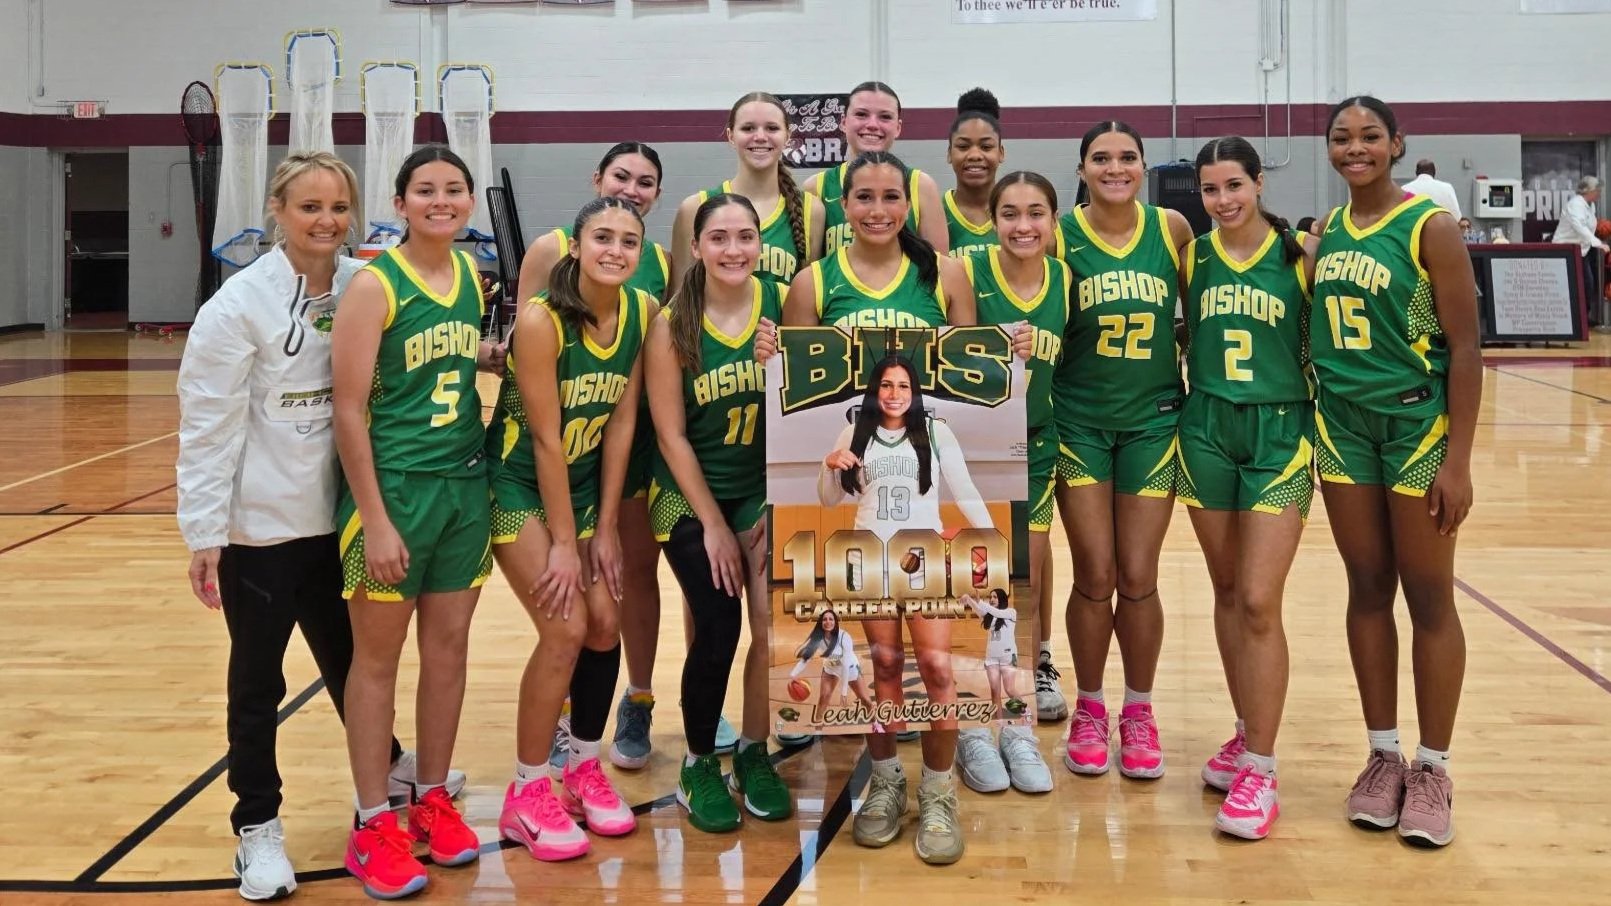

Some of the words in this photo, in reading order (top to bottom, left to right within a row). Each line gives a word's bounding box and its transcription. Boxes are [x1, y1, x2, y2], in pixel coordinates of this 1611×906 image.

[974, 0, 1001, 11] thee
[1070, 0, 1086, 9] be
[1089, 0, 1121, 9] true.
[77, 103, 97, 116] EXIT
[798, 116, 820, 132] To
[816, 116, 838, 132] Be
[799, 99, 820, 116] A
[1078, 270, 1169, 312] BISHOP
[1315, 250, 1391, 296] BISHOP
[1200, 284, 1286, 327] BISHOP
[1325, 295, 1373, 350] 15
[404, 320, 481, 373] BISHO
[1096, 312, 1156, 360] 22
[1223, 329, 1253, 382] 2
[776, 326, 1012, 414] BHS
[430, 370, 461, 428] 5
[723, 403, 759, 446] 11
[877, 486, 911, 522] 13
[783, 528, 1010, 612] 1000
[795, 600, 899, 622] CAREER
[904, 600, 978, 621] POIN
[809, 697, 872, 726] Leah
[876, 697, 998, 724] Gutierrez
